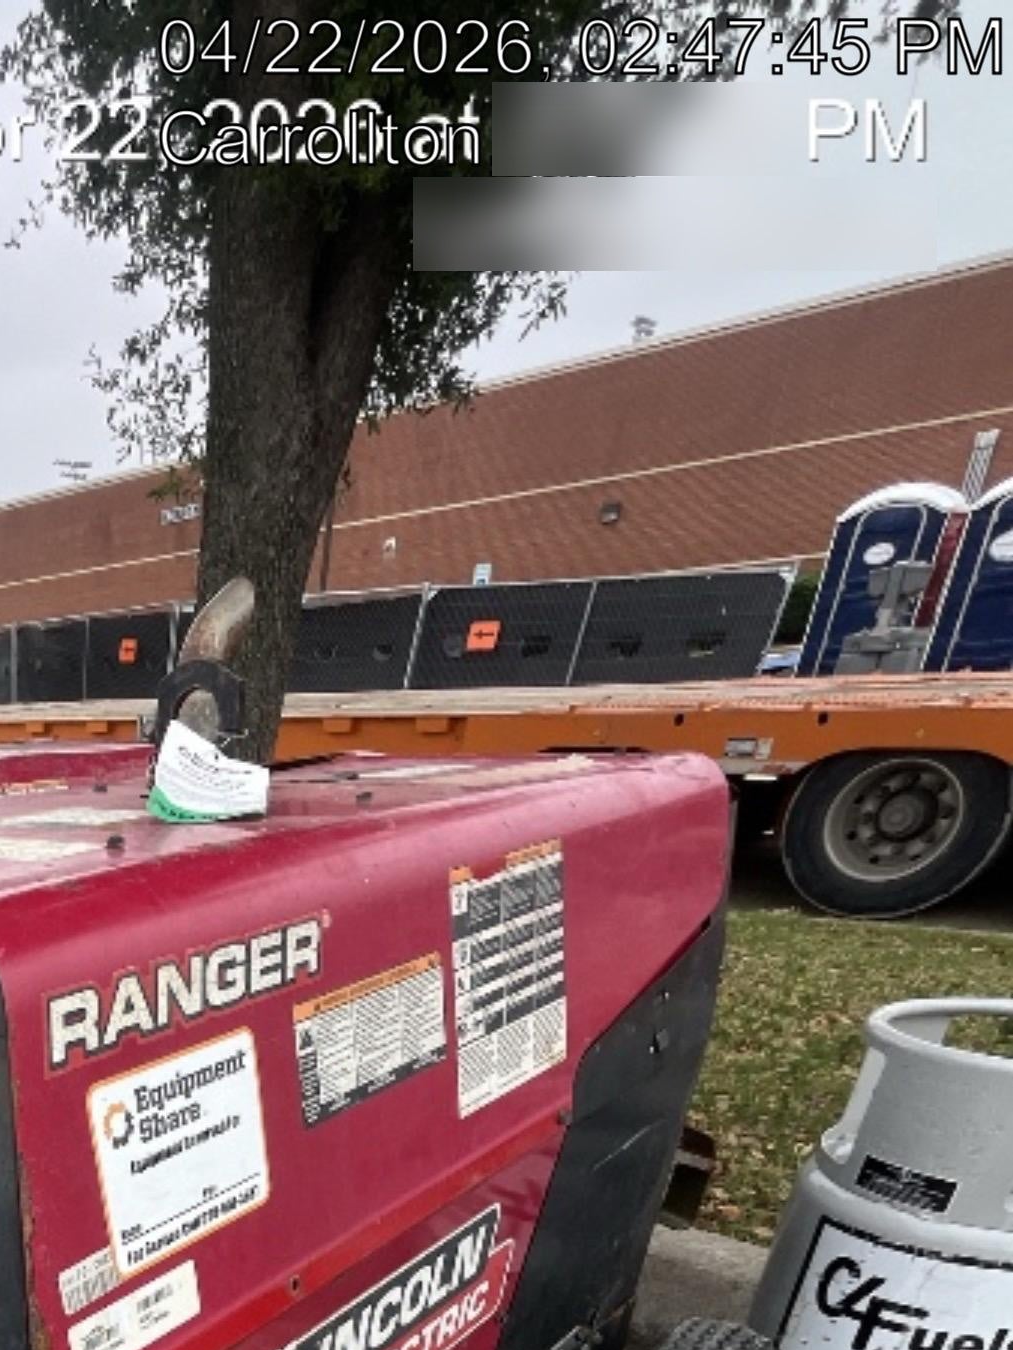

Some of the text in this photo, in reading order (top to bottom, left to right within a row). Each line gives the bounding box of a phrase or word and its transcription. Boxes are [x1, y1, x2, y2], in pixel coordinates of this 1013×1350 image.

[47, 918, 322, 1068] RANGER
[134, 1050, 246, 1113] Equipment
[139, 1101, 201, 1144] Share
